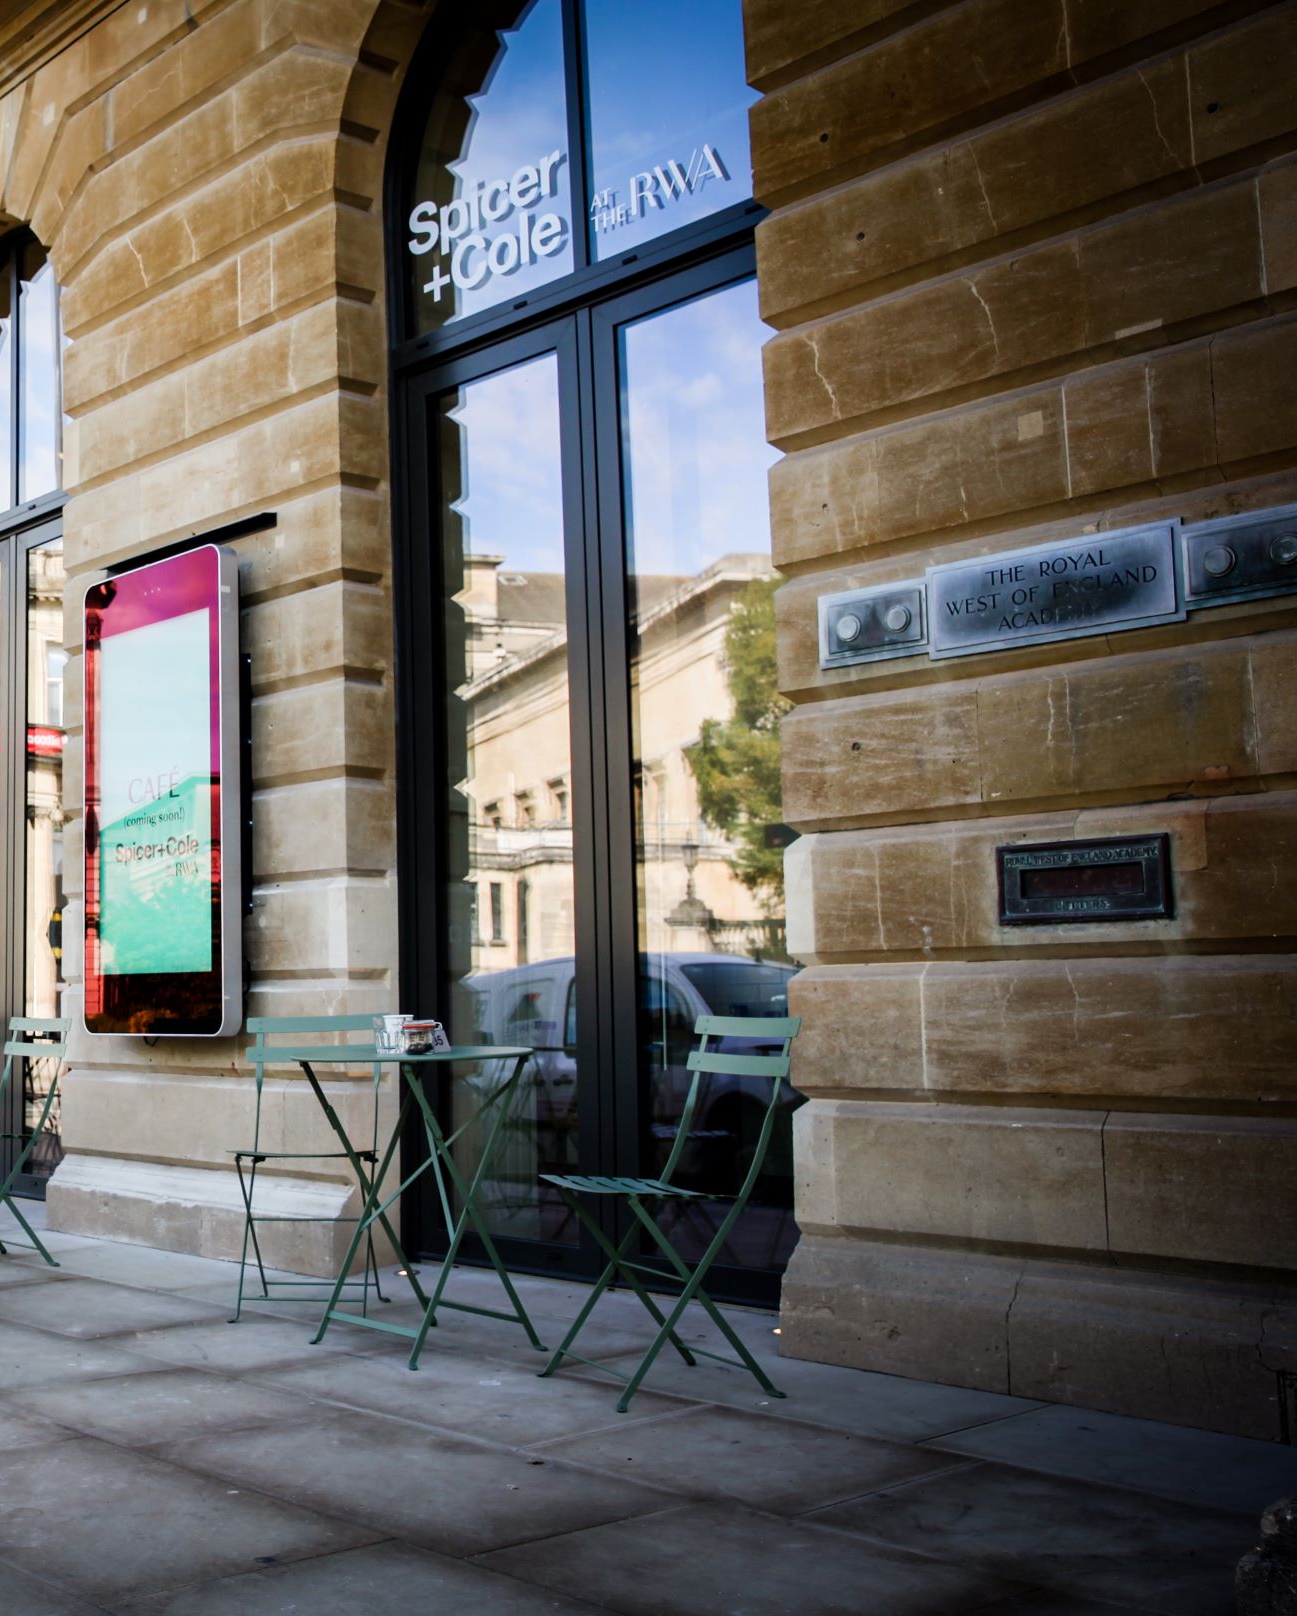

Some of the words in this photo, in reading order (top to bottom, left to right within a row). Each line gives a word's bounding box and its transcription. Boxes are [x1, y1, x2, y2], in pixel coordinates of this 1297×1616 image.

[408, 149, 560, 255] Spicer
[590, 203, 627, 232] THE
[630, 143, 723, 216] RWA
[590, 187, 612, 212] AT
[423, 210, 562, 302] +Cole
[985, 565, 1025, 586] THE
[1039, 550, 1111, 577] ROYAL
[946, 593, 1001, 616] WEST
[1011, 585, 1039, 606] OF
[1052, 565, 1157, 596] ENGLAND
[128, 765, 180, 804] CAFÉ
[123, 812, 157, 829] (coming
[158, 807, 185, 823] soon!)
[115, 834, 199, 866] Spicer+Cole
